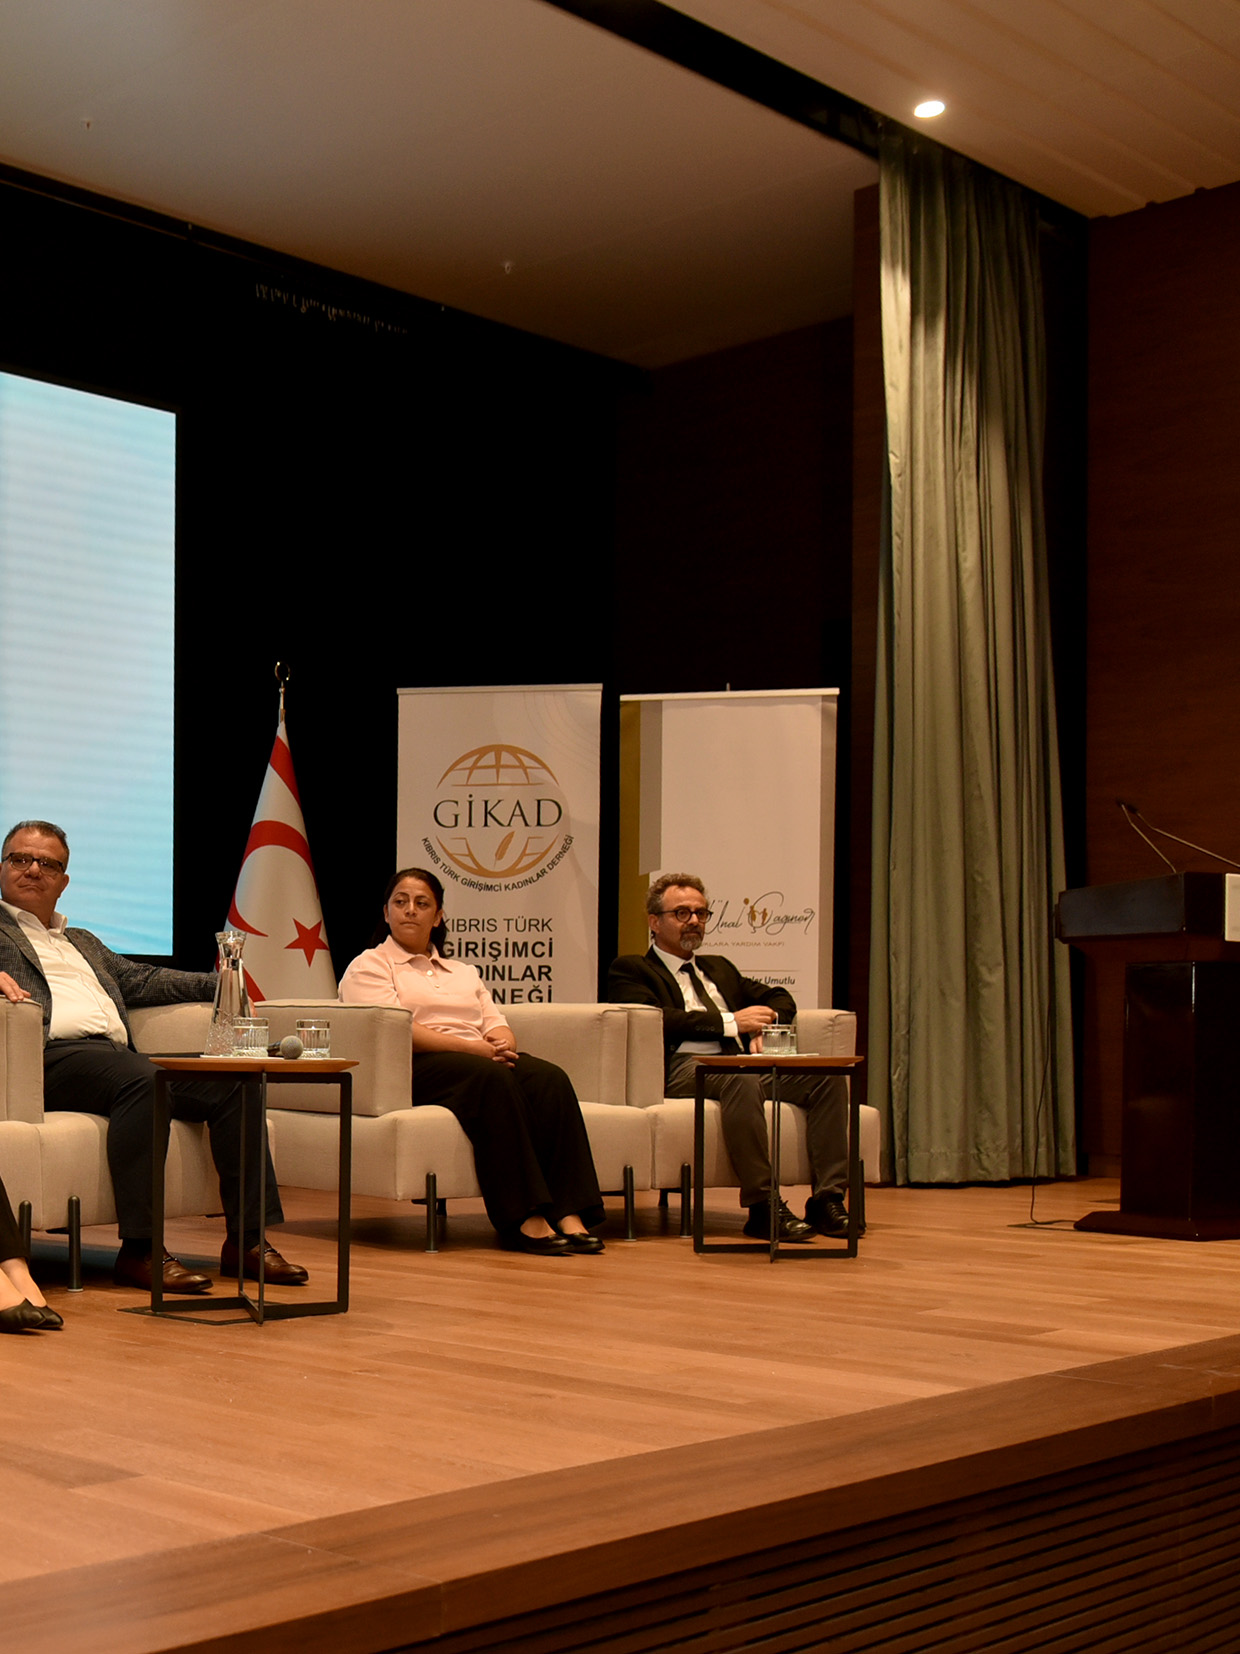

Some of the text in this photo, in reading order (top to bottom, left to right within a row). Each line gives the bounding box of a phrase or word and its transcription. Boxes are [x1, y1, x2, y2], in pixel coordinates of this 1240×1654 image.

[433, 793, 563, 829] GİKAD
[421, 834, 575, 893] KIBRIS TÜRK GİRİŞİMCİ KADINLAR DERNEĞİ
[444, 915, 553, 933] KIBRIS TÜRK
[443, 937, 553, 962] GİRİŞİMCİ
[478, 965, 553, 982] DINLAR
[764, 976, 796, 985] Umutlu
[492, 985, 553, 1004] NEĞİ
